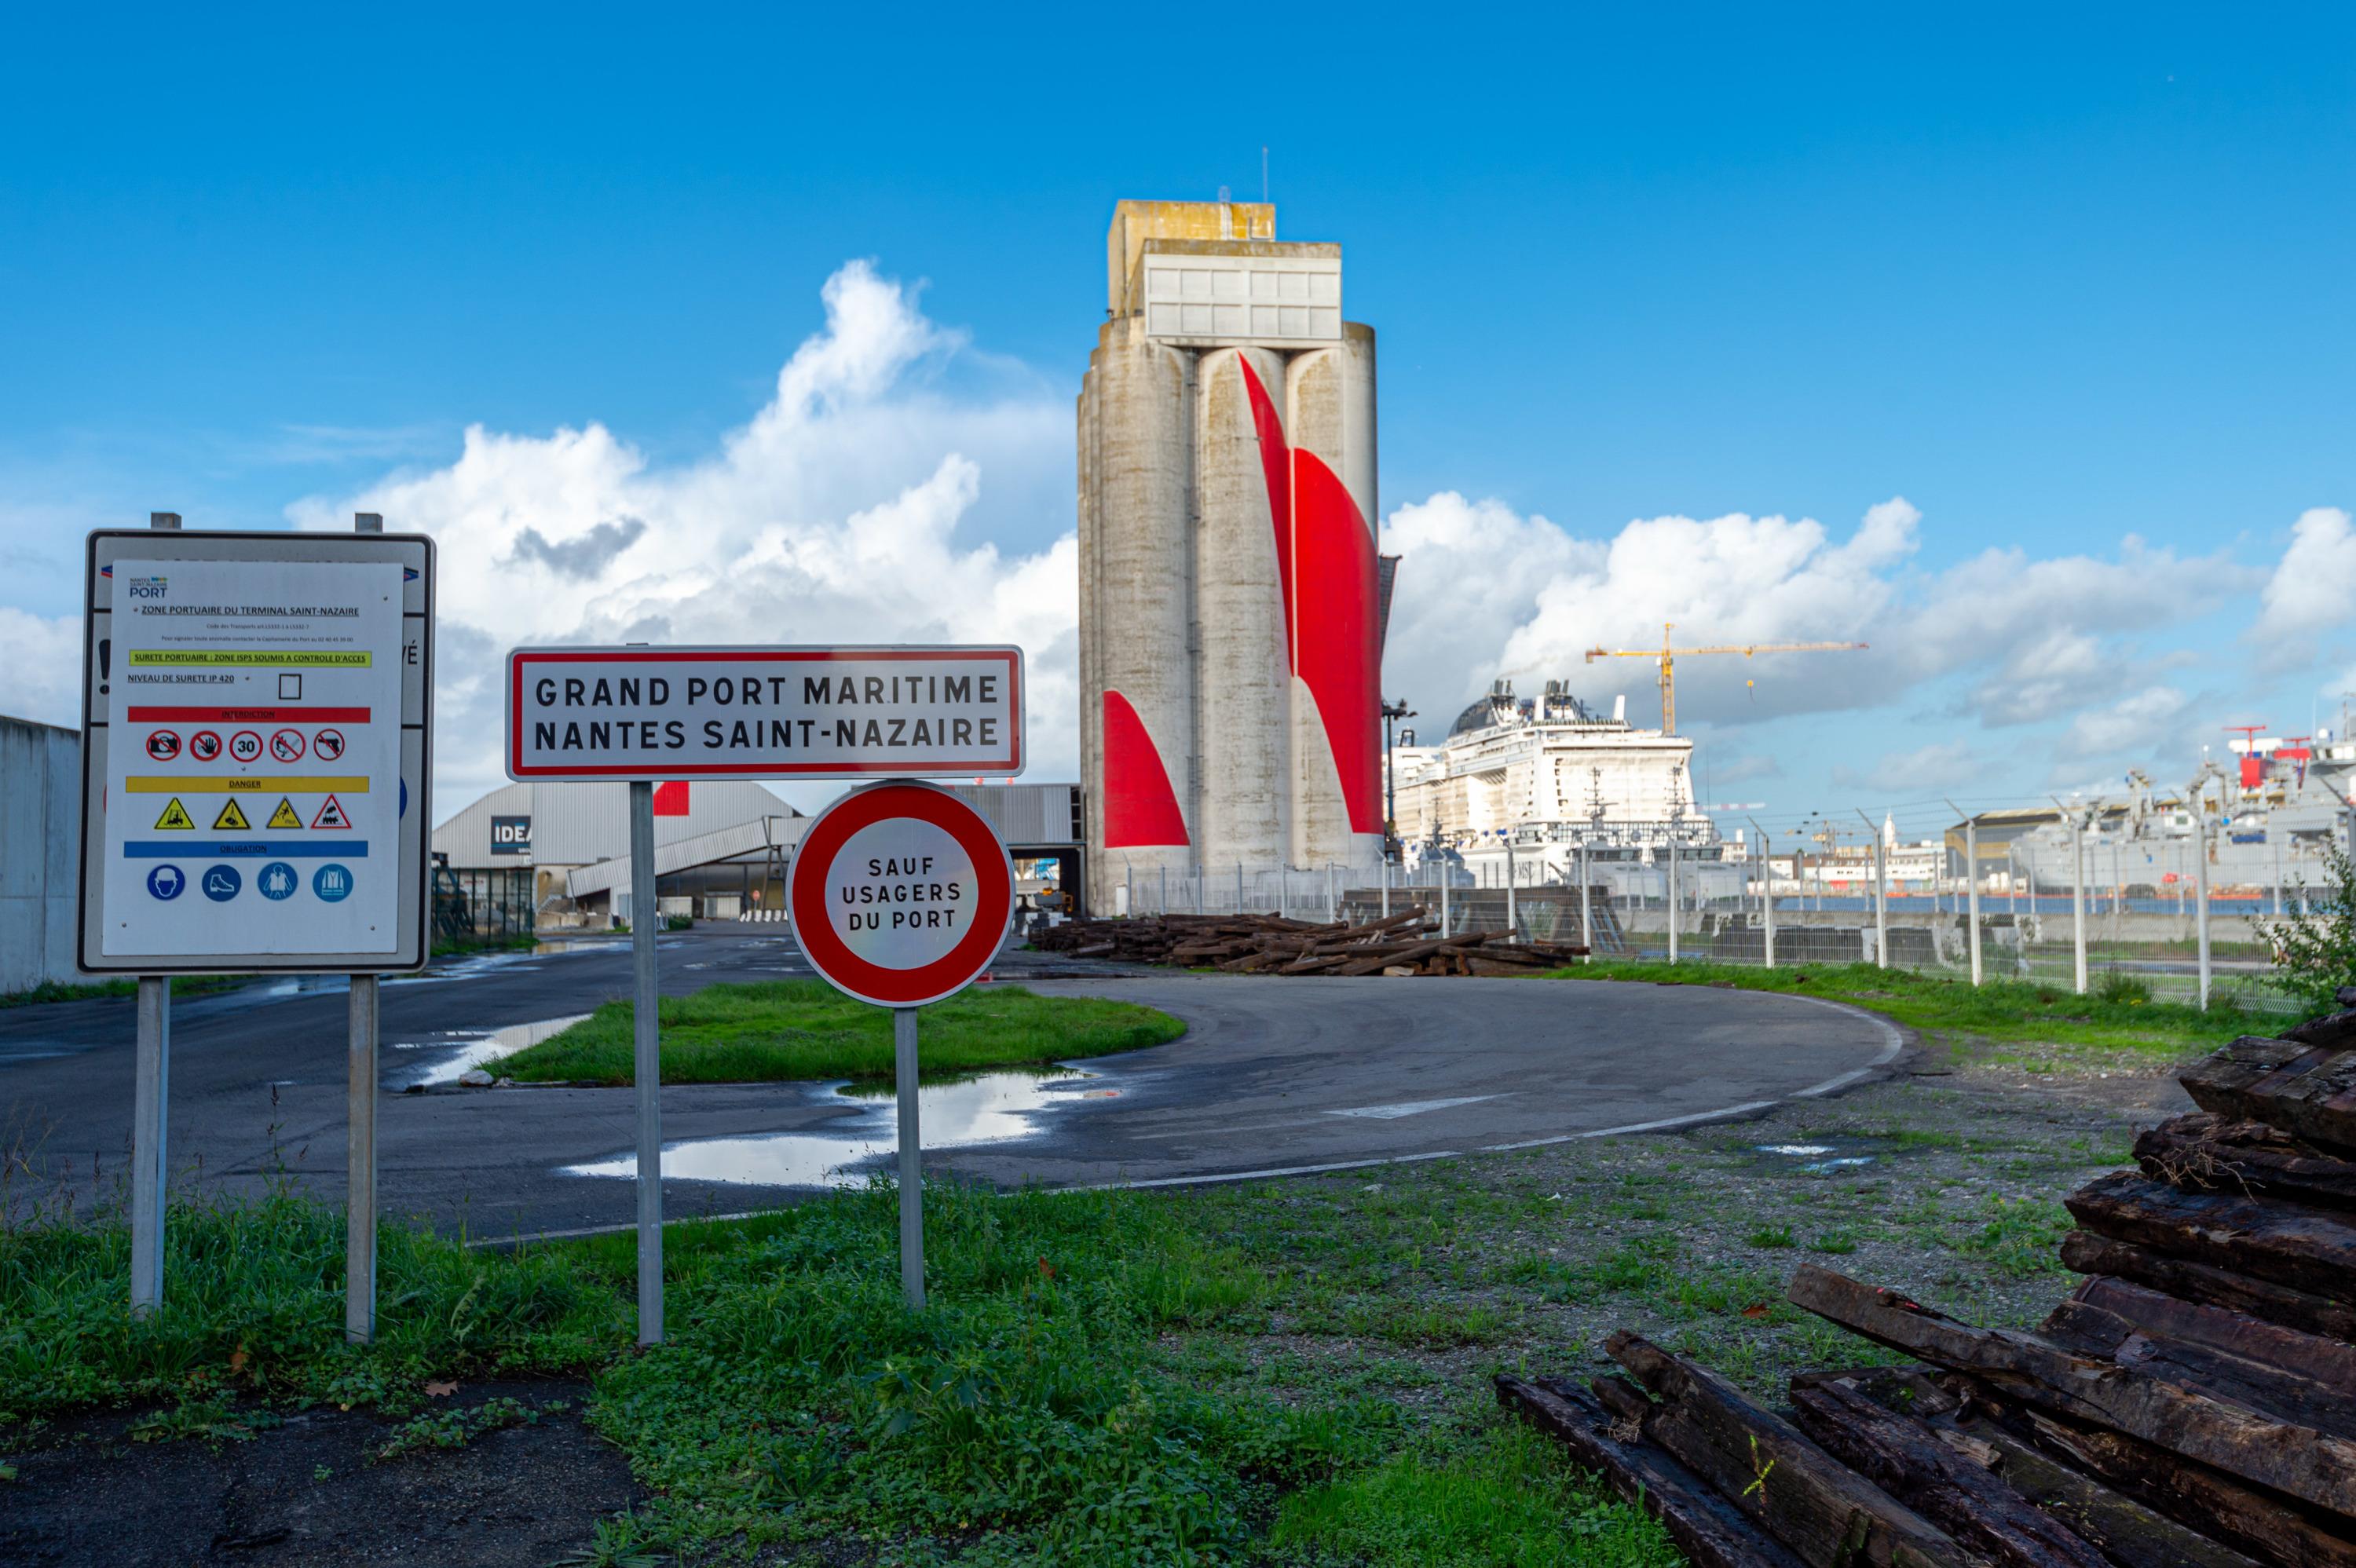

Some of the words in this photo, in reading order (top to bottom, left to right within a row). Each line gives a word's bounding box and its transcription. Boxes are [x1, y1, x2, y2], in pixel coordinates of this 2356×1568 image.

[130, 587, 168, 598] PORT
[141, 605, 166, 615] ZONE
[169, 605, 222, 615] PORTUAIRE
[225, 606, 238, 616] DU
[240, 606, 288, 616] TERMINAL
[289, 607, 360, 617] SAINT-NAZAIRE
[134, 653, 163, 662] SURETE
[165, 653, 208, 663] PORTUAIRE
[214, 654, 235, 663] ZONE
[236, 654, 252, 663] ISPS
[254, 654, 284, 663] SOUMIS
[286, 654, 291, 663] A
[293, 654, 334, 663] CONTROLE
[335, 654, 366, 663] D'ACCES
[127, 674, 160, 683] NIVEAU
[163, 674, 174, 683] DE
[175, 674, 207, 683] SURETE
[209, 674, 217, 683] IP
[219, 674, 235, 683] 420
[536, 678, 669, 707] GRAND
[688, 677, 785, 706] PORT
[804, 676, 997, 704] MARITIME
[221, 710, 276, 718] INTERDICTION
[536, 720, 685, 751] NANTES
[703, 718, 997, 749] SAINT-NAZAIRE
[238, 740, 255, 753] 30
[229, 780, 262, 789] DANGER
[219, 845, 267, 854] OBLIGATION
[869, 857, 933, 877] SAUF
[843, 883, 960, 904] USAGERS
[849, 912, 880, 930] DU
[892, 909, 955, 929] PORT
